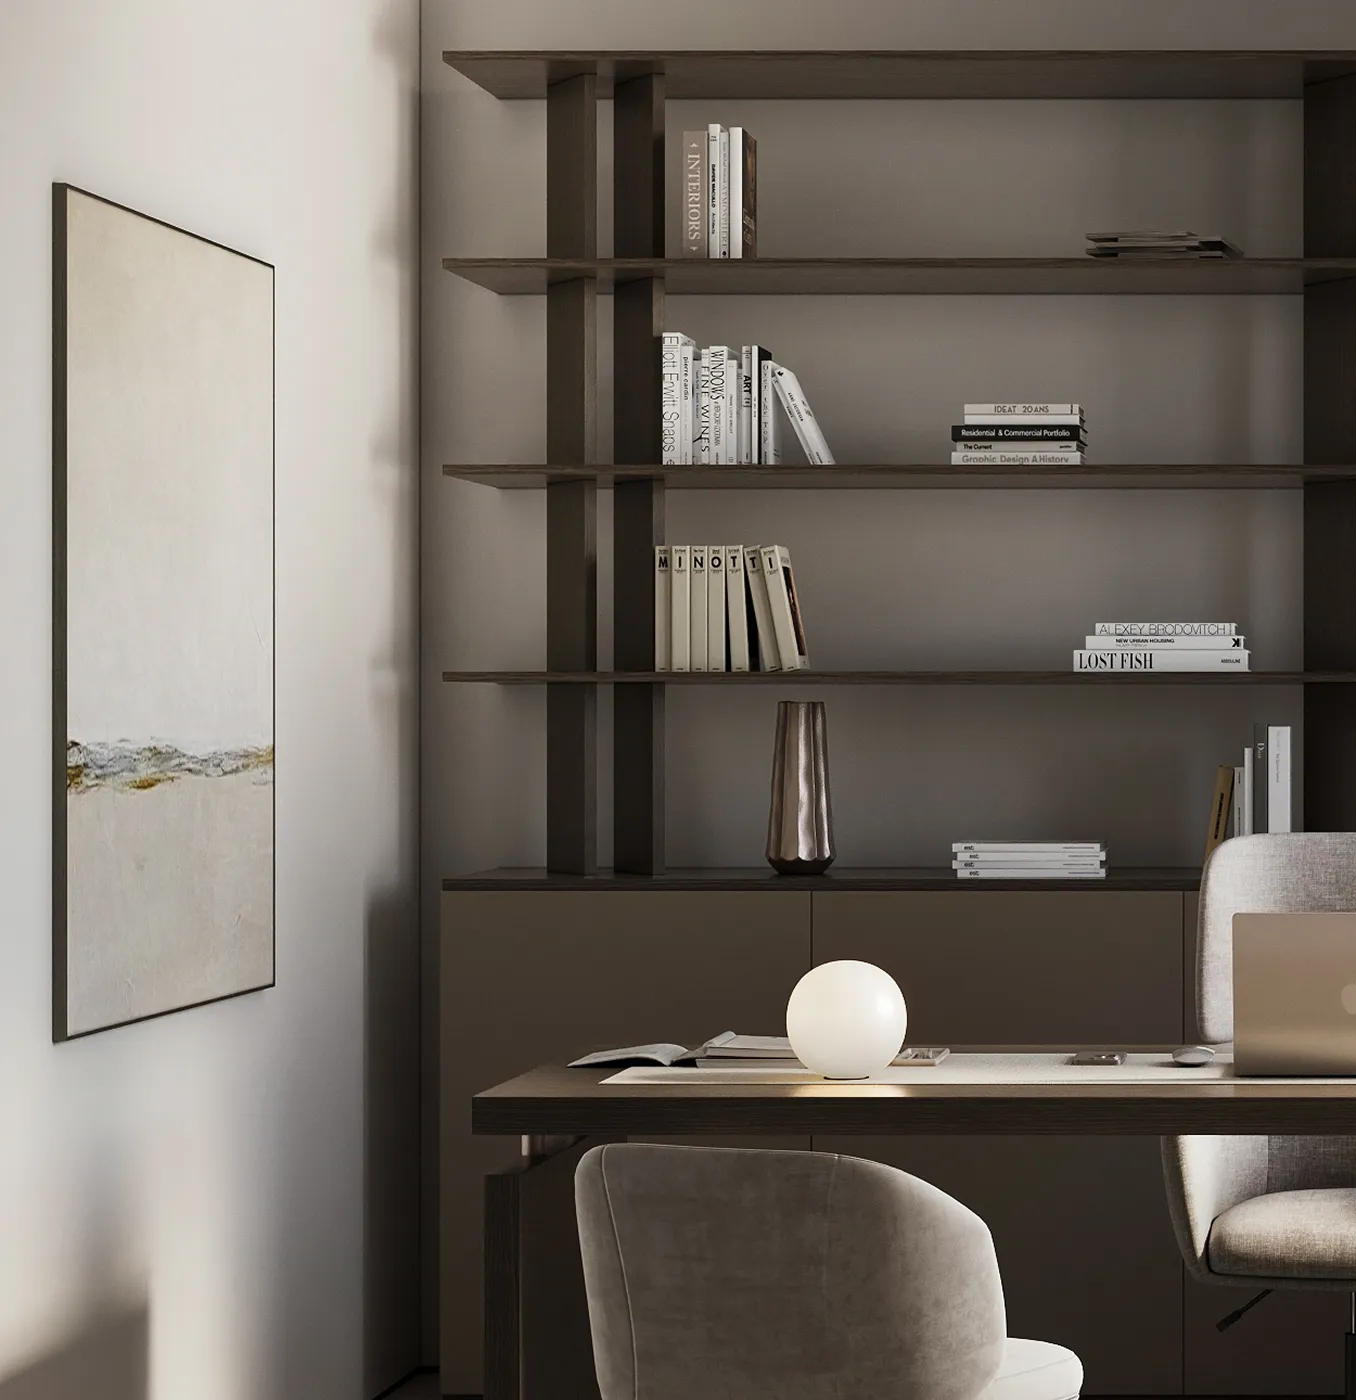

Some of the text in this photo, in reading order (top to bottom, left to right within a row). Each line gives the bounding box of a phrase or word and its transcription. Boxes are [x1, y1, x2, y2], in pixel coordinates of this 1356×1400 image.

[688, 153, 700, 240] INTERIORS
[663, 336, 679, 368] Elliott
[663, 373, 679, 407] Erwitt
[710, 350, 725, 400] WINDOWS
[743, 375, 752, 394] ART
[702, 366, 710, 452] FINE WINES
[1000, 455, 1030, 465] Design
[1032, 455, 1039, 463] A
[1040, 455, 1069, 463] History
[1100, 623, 1226, 635] ALEXEY BRODOVITCH
[1079, 653, 1153, 670] LOST FISH
